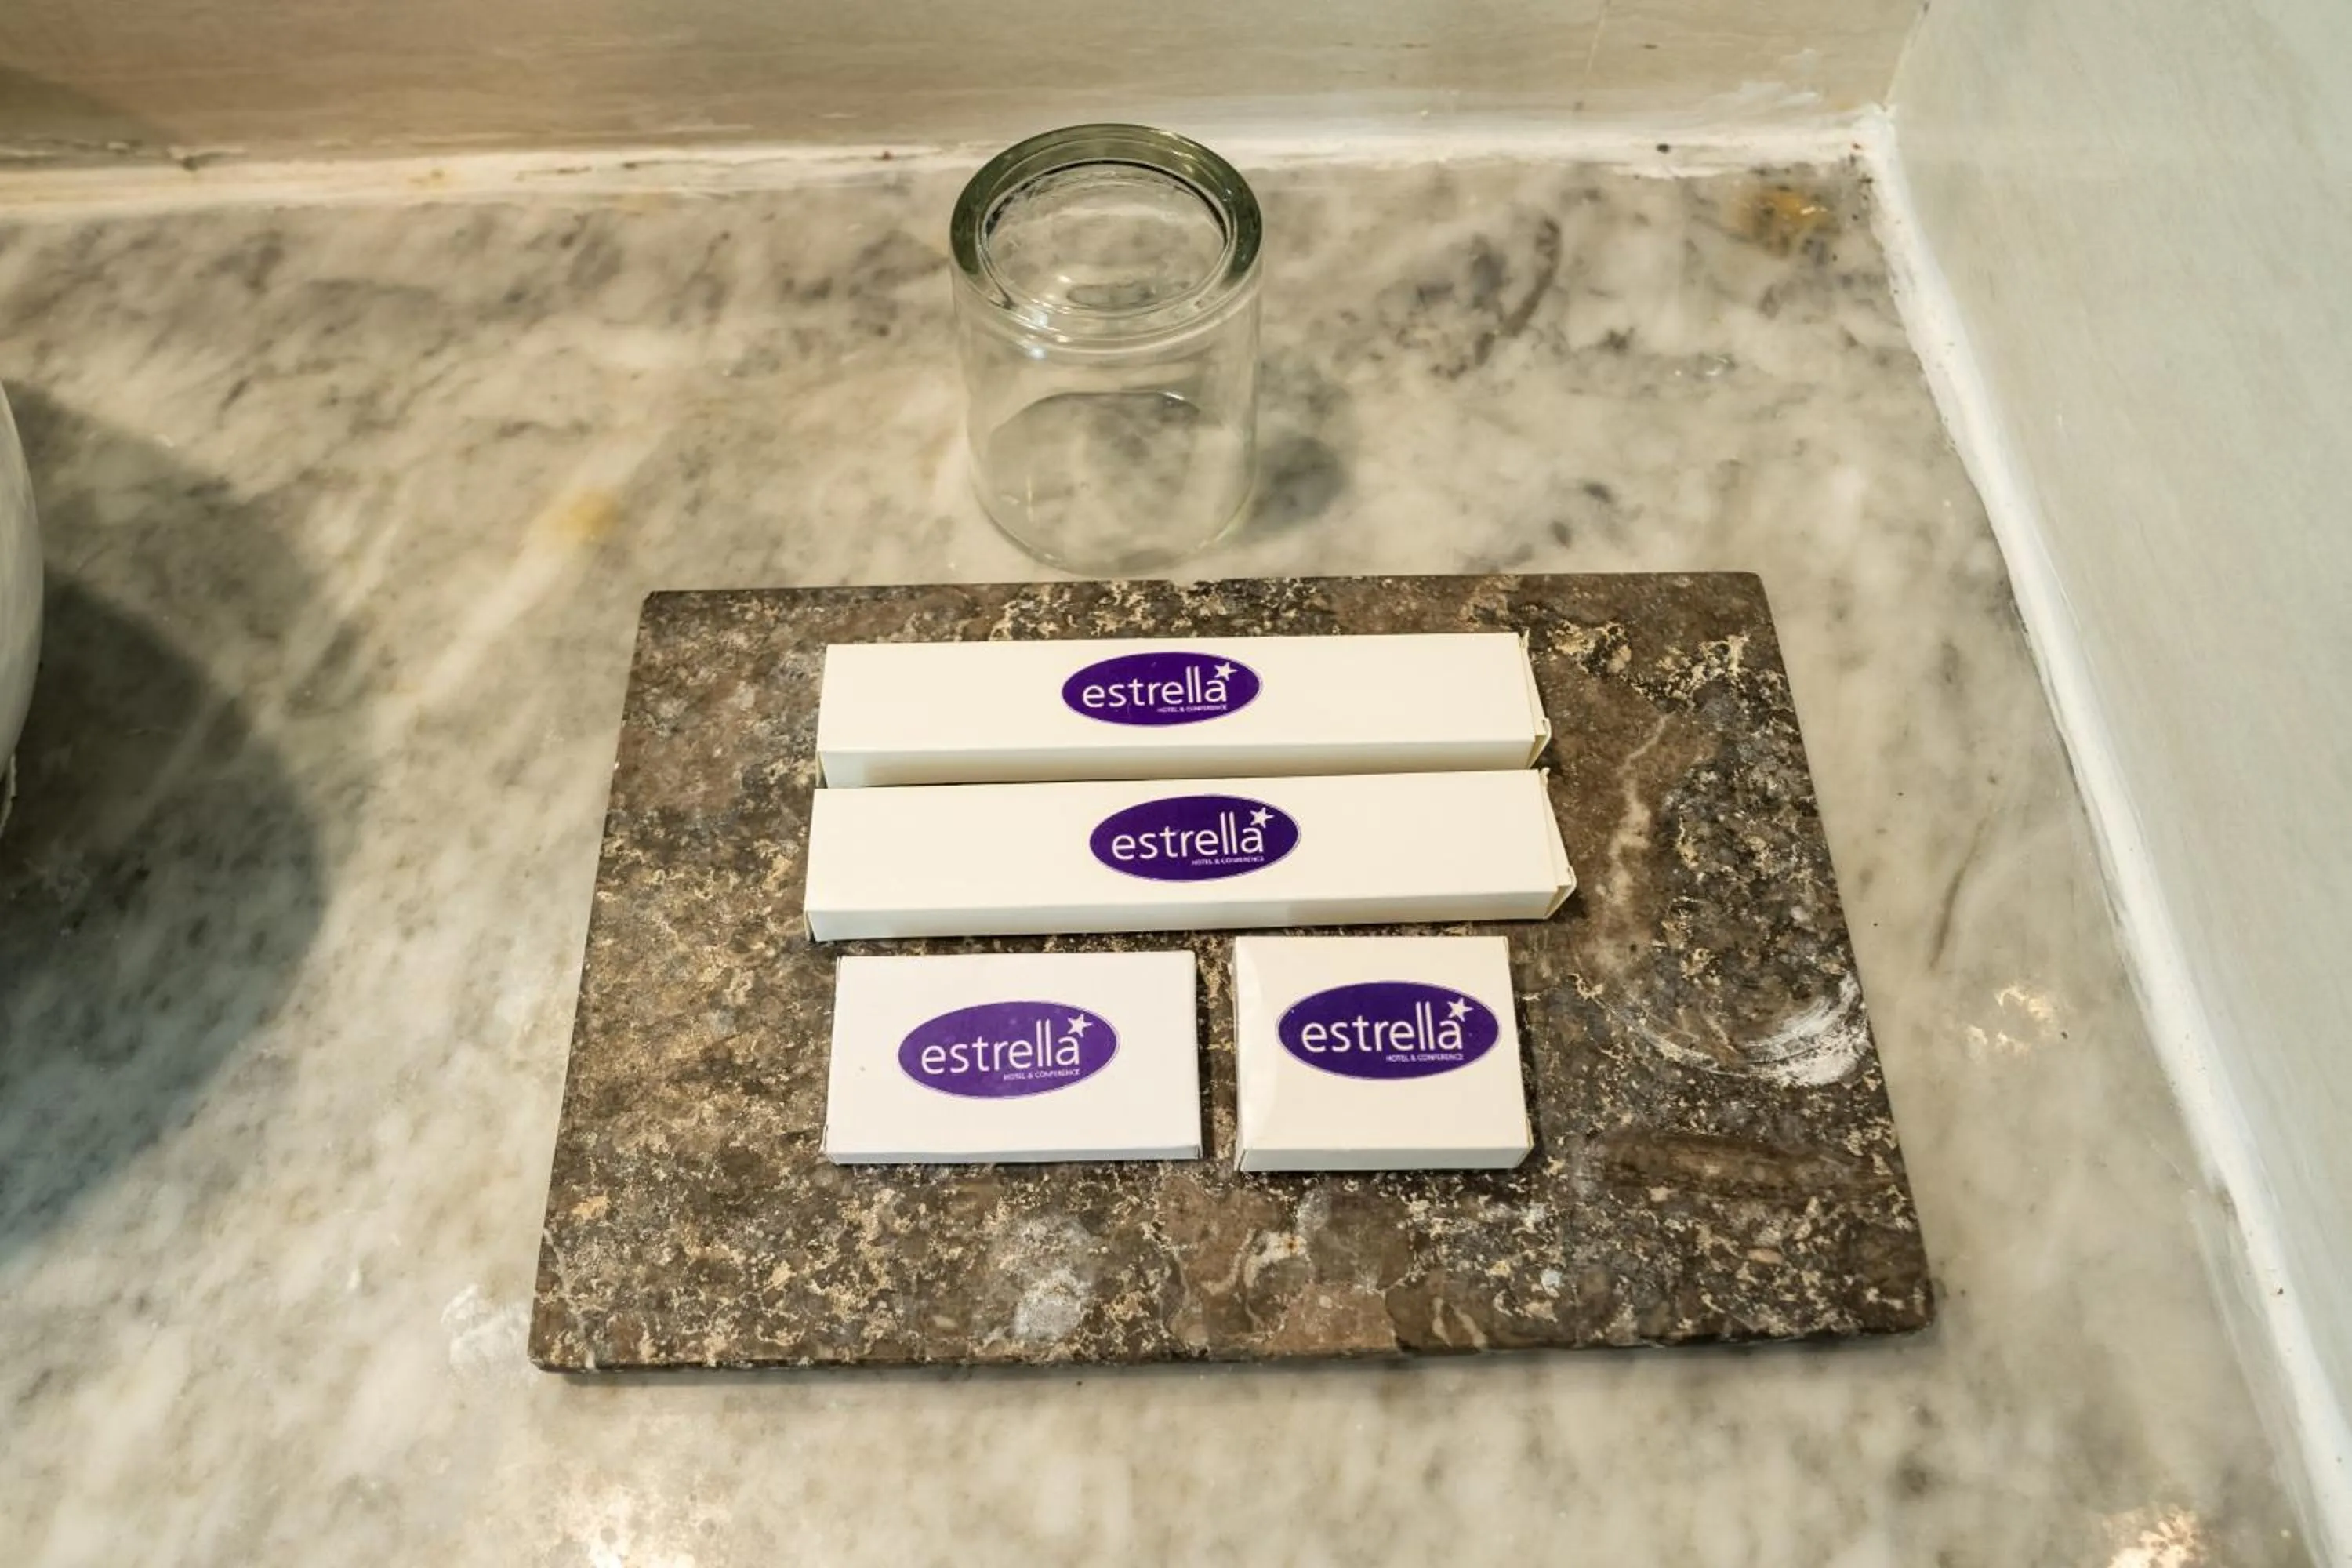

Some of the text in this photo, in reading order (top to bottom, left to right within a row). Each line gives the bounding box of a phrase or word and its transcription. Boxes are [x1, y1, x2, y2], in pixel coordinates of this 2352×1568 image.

[1082, 666, 1227, 708] estrella
[1112, 811, 1264, 861] estrella
[921, 1018, 1080, 1075] estrella
[1301, 1000, 1463, 1053] estrella
